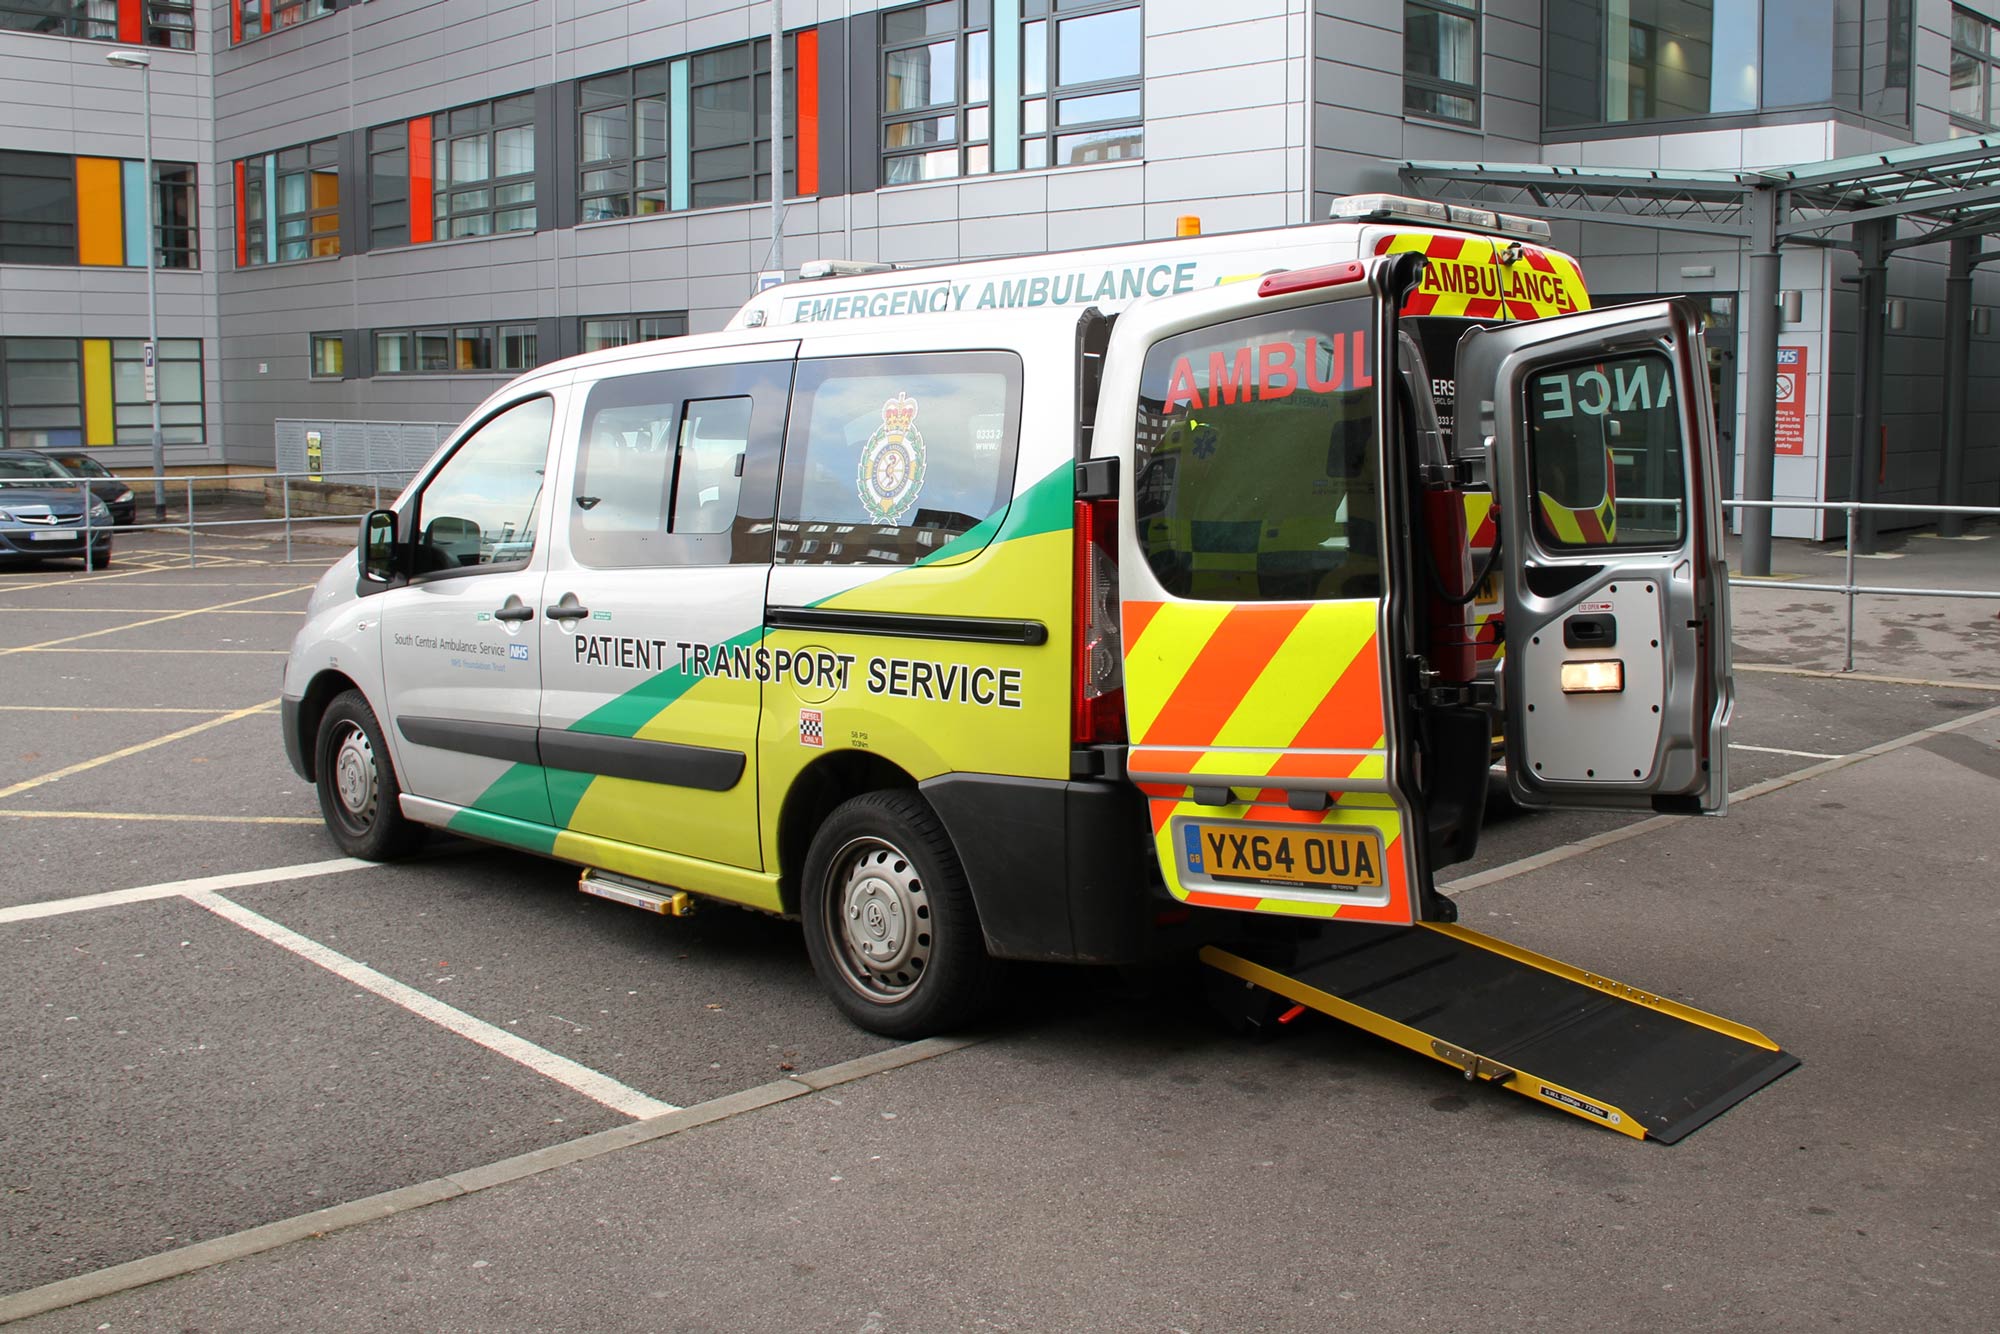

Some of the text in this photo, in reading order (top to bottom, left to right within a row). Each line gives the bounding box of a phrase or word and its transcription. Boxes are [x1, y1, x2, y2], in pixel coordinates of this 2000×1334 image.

[795, 262, 1198, 323] EMERGENCY AMBULANCE
[1424, 262, 1567, 306] AMBULANCE
[1162, 330, 1373, 414] AMBUL
[394, 633, 528, 659] South Central Ambulance Service NHS
[574, 634, 1023, 709] PATIENT TRANSPORT SERVICE
[801, 711, 820, 721] DIESEL
[804, 735, 819, 744] ONLY
[1189, 853, 1201, 863] GB
[1207, 832, 1375, 878] YX64 OUA
